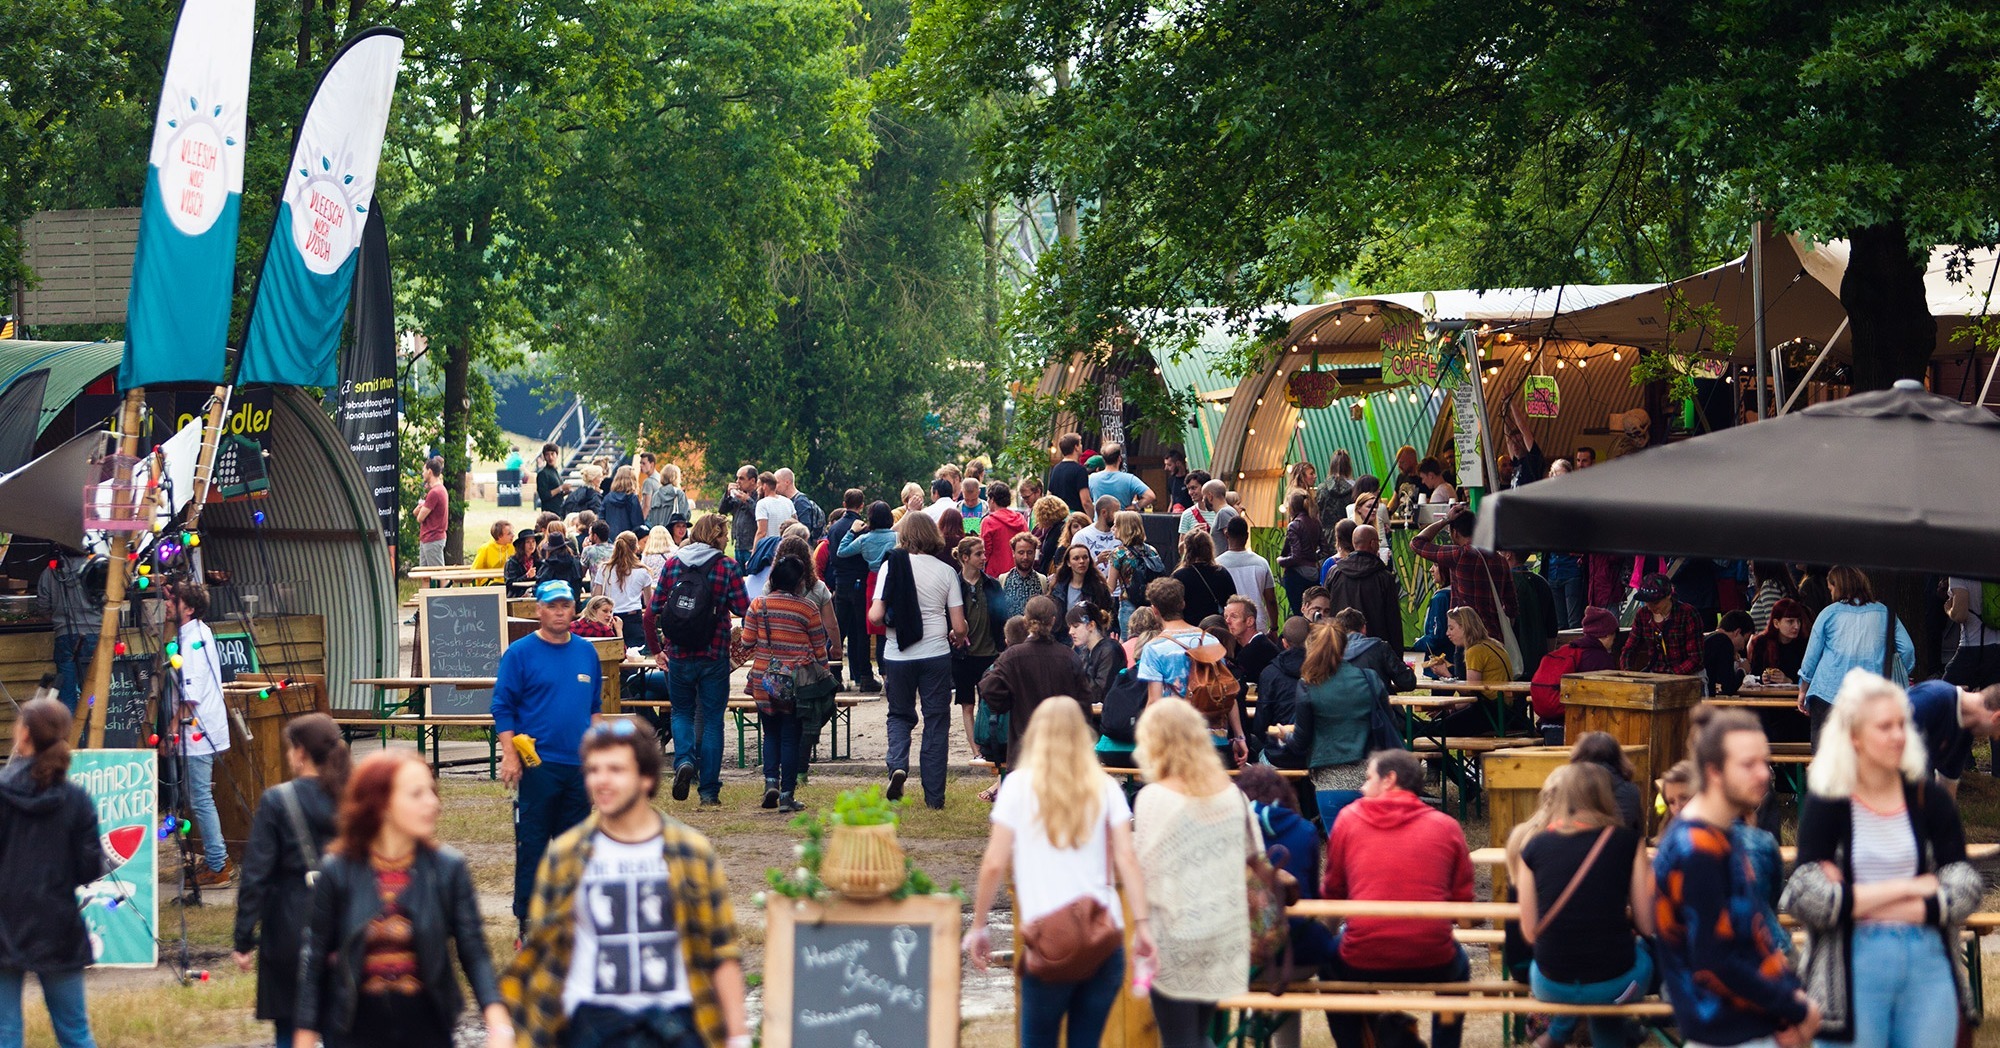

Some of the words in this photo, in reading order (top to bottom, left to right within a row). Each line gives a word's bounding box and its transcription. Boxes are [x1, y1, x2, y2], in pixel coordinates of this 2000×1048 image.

[181, 139, 217, 171] VLEESCH
[188, 169, 204, 188] NOCH
[180, 188, 204, 218] VISCH
[309, 189, 345, 228] VLEESCH
[313, 217, 329, 237] NOCH
[305, 230, 331, 262] VISCH
[1102, 427, 1125, 444] KEBAB
[431, 598, 477, 619] Sushi
[453, 619, 486, 635] time
[217, 640, 248, 666] BAR
